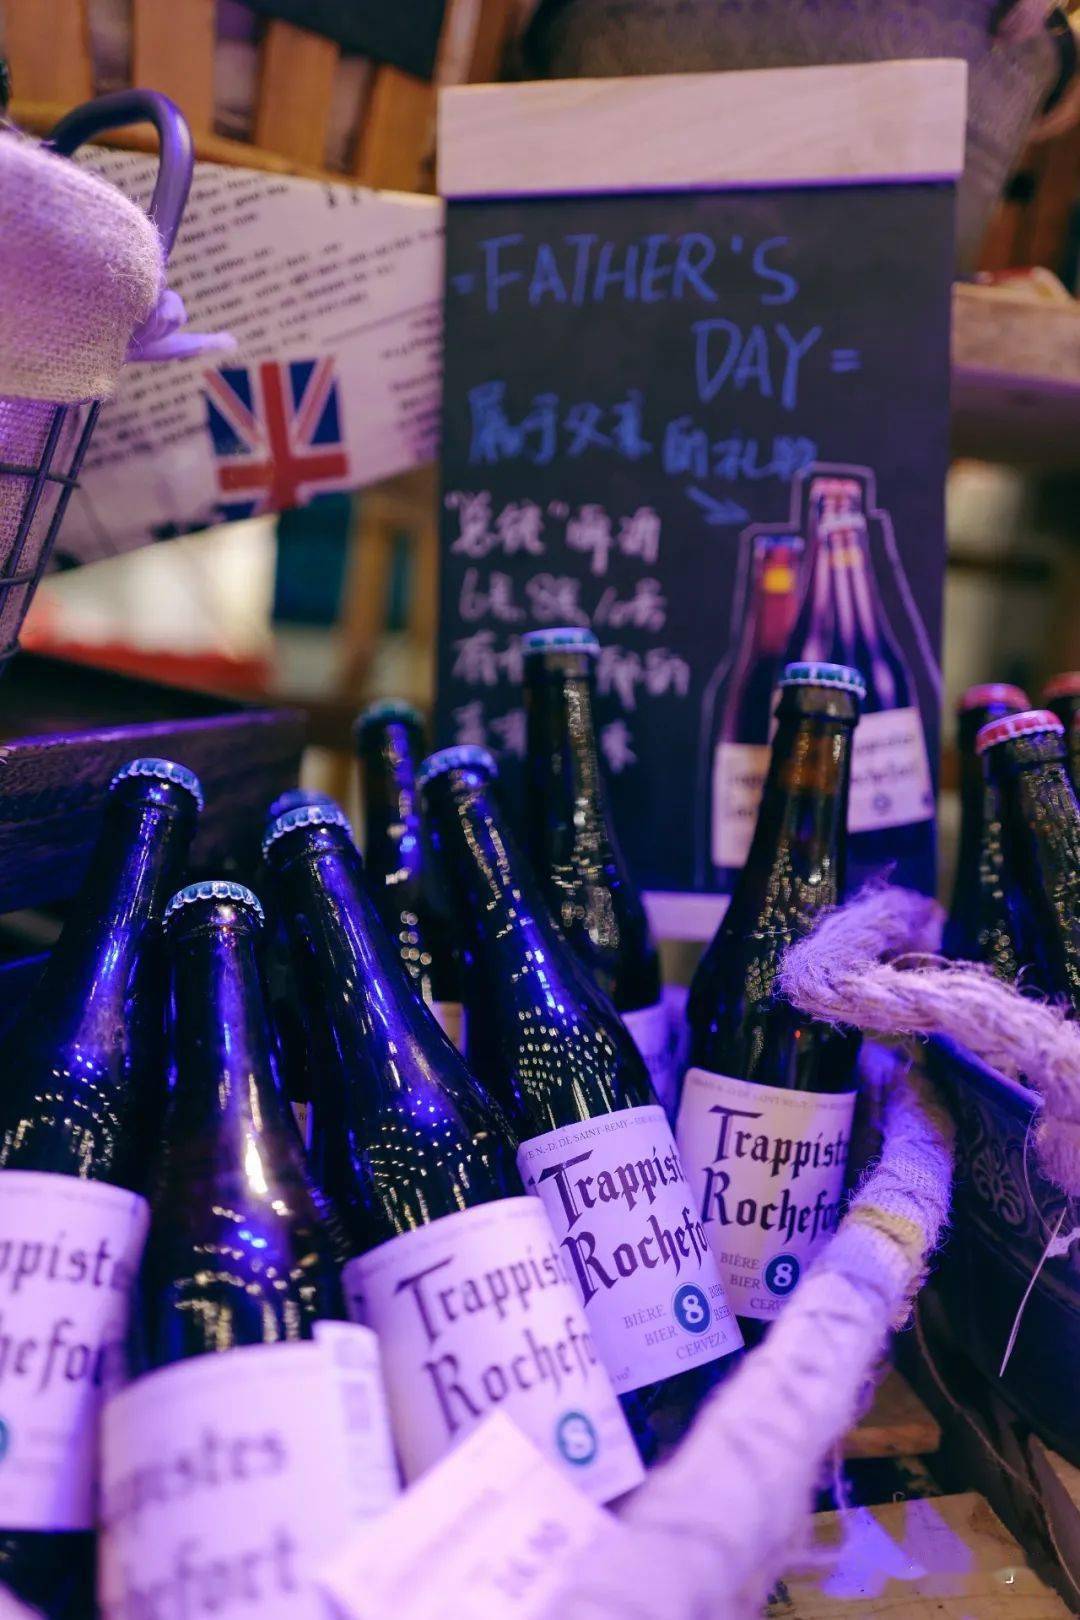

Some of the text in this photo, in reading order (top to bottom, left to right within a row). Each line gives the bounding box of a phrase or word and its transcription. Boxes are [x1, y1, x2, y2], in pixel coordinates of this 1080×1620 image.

[692, 318, 823, 410] DAY
[730, 1274, 760, 1290] BIER
[773, 1263, 794, 1288] 8
[682, 1294, 704, 1323] 8
[644, 1325, 679, 1347] BIER
[675, 1330, 728, 1360] CERVEZA
